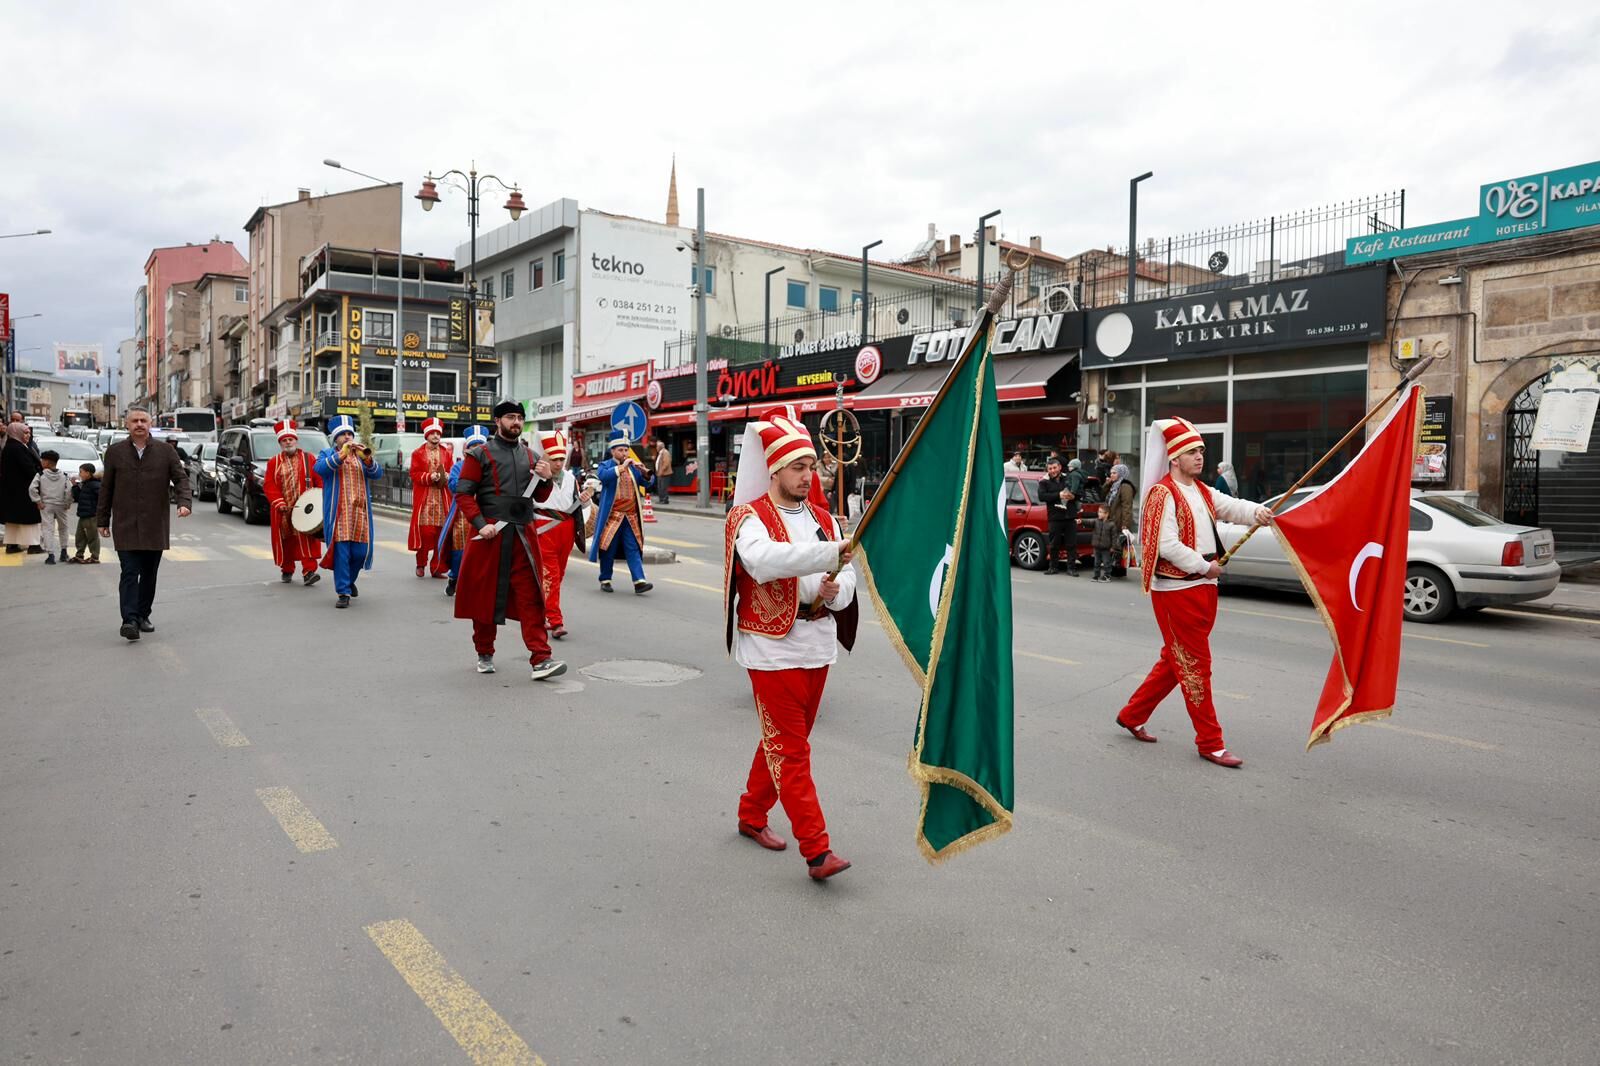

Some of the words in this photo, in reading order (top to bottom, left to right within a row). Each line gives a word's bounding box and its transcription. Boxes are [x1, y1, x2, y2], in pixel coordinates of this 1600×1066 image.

[1496, 221, 1539, 236] HOTELS
[1352, 240, 1384, 257] Kafe
[1388, 225, 1471, 249] Restaurant
[591, 252, 645, 276] tekno
[612, 300, 634, 310] 0384
[636, 302, 652, 312] 251
[654, 304, 664, 313] 21
[667, 305, 677, 315] 21
[451, 299, 462, 340] UZER
[350, 309, 361, 386] DÖNER
[779, 345, 794, 359] ALO
[795, 342, 818, 356] PAKET
[819, 339, 835, 352] 213
[836, 337, 848, 350] 22
[907, 327, 970, 366] FOT
[991, 313, 1064, 355] CAN
[631, 370, 646, 390] ET
[796, 369, 833, 386] NEVŞEHİR
[337, 399, 377, 407] İSKEER
[384, 402, 412, 410] HAAY
[417, 402, 445, 412] DÖNER
[402, 393, 429, 402] ERVAN
[900, 396, 932, 406] FOT
